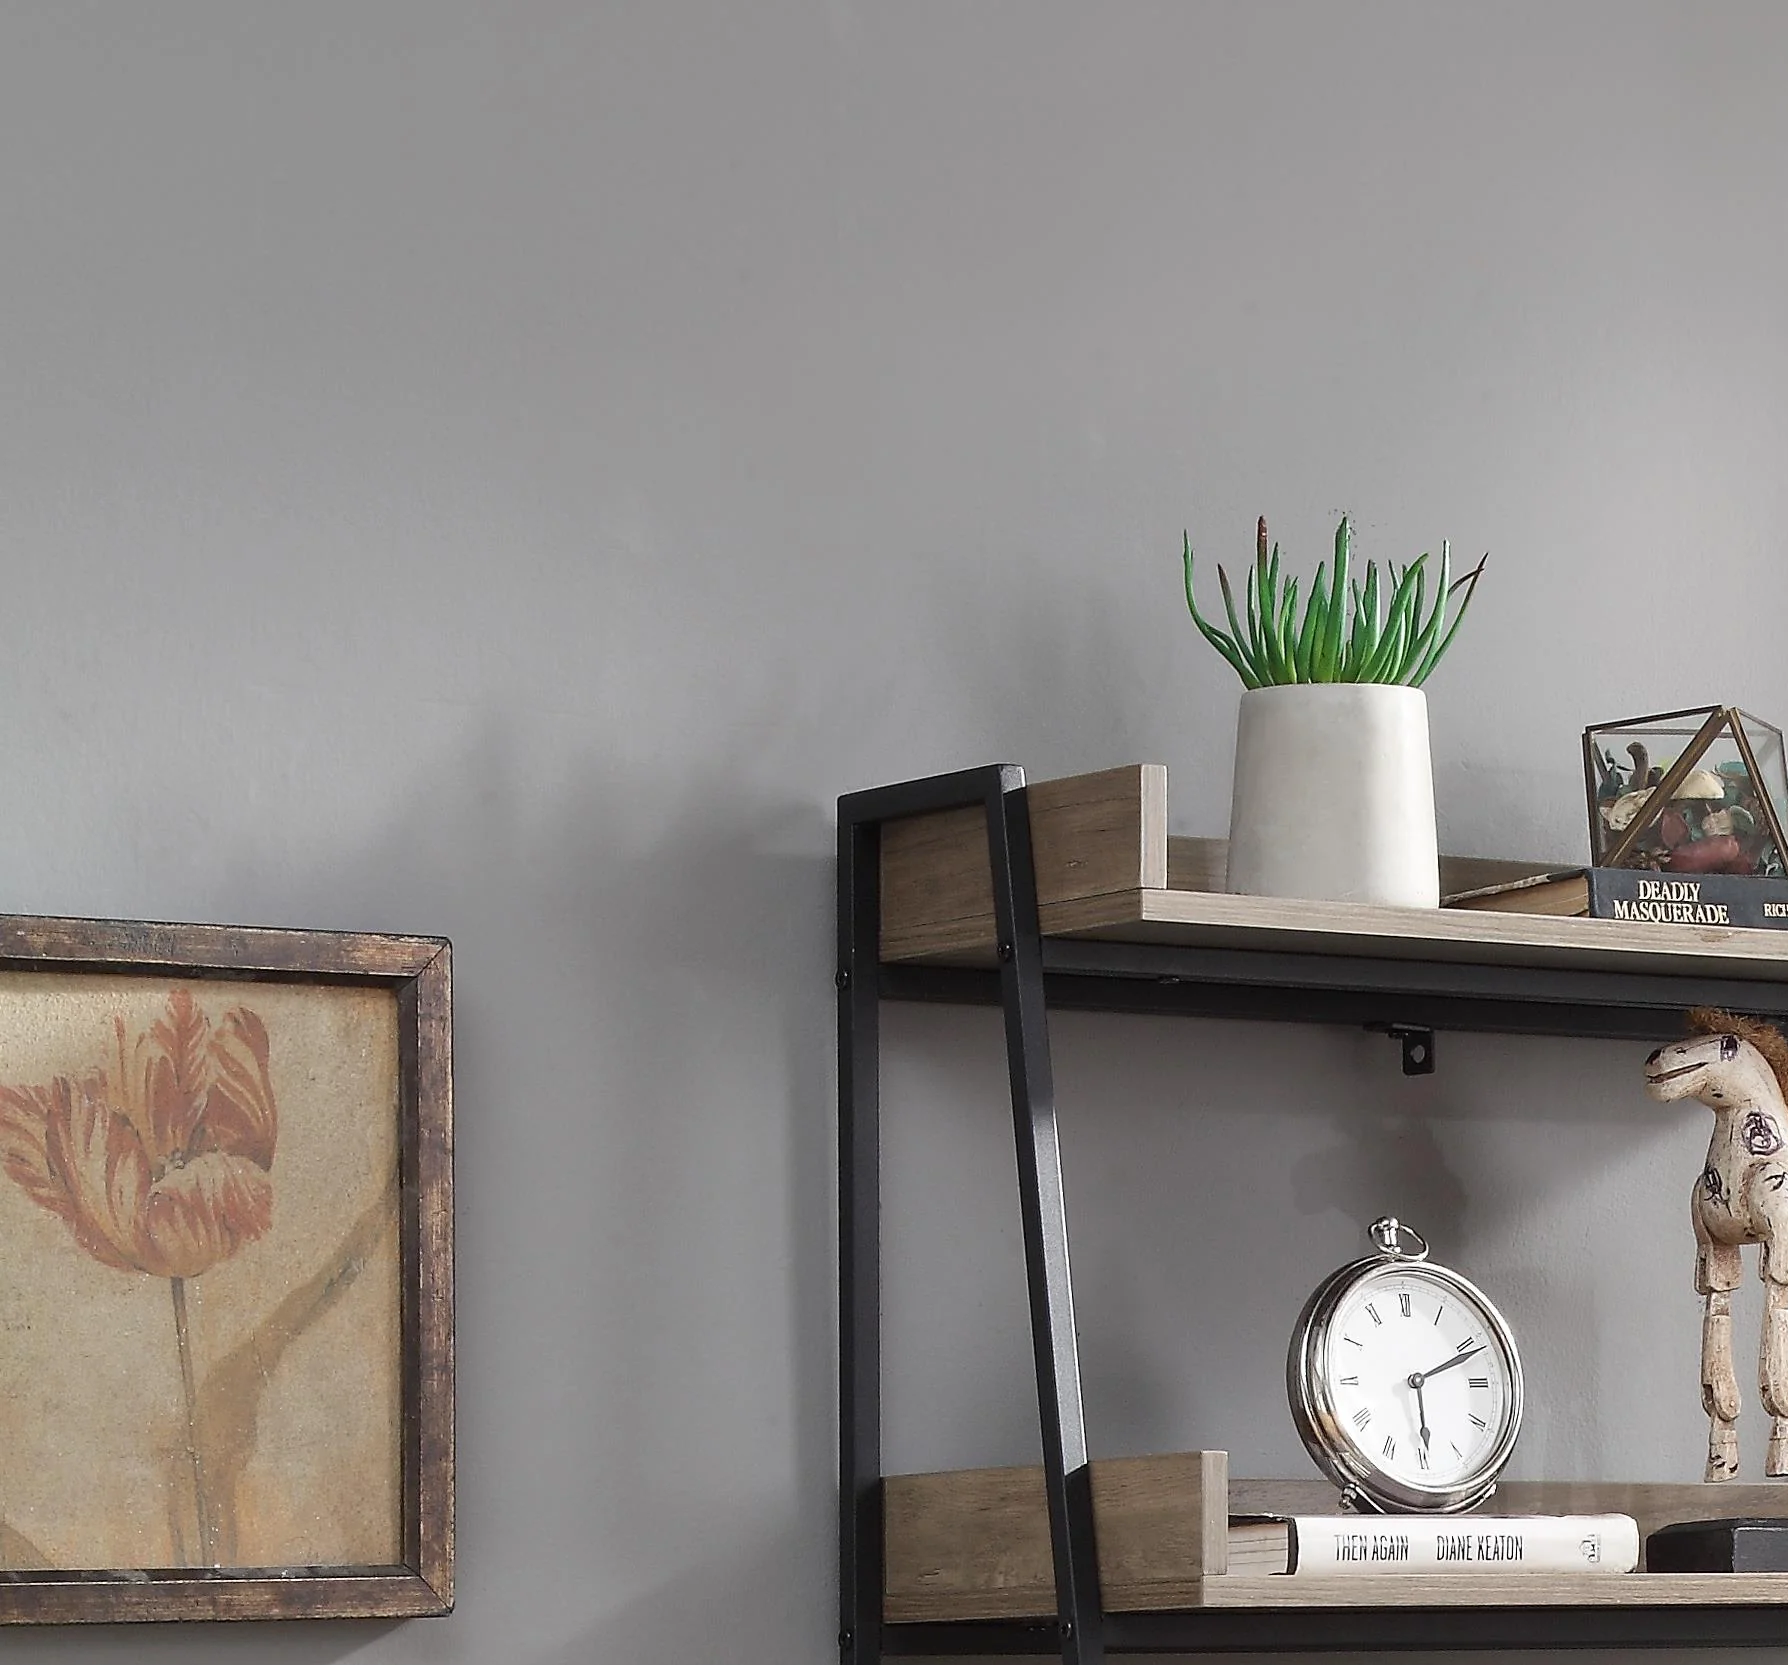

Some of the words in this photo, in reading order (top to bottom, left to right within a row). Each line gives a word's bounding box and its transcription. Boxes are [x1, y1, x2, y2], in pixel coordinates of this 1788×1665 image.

[1638, 880, 1701, 901] DEADLY
[1613, 900, 1730, 925] MASQUERADE
[1334, 1535, 1367, 1561] THEN
[1372, 1535, 1409, 1561] AGAIN
[1436, 1535, 1473, 1561] DIANE
[1477, 1535, 1523, 1561] KEATON
